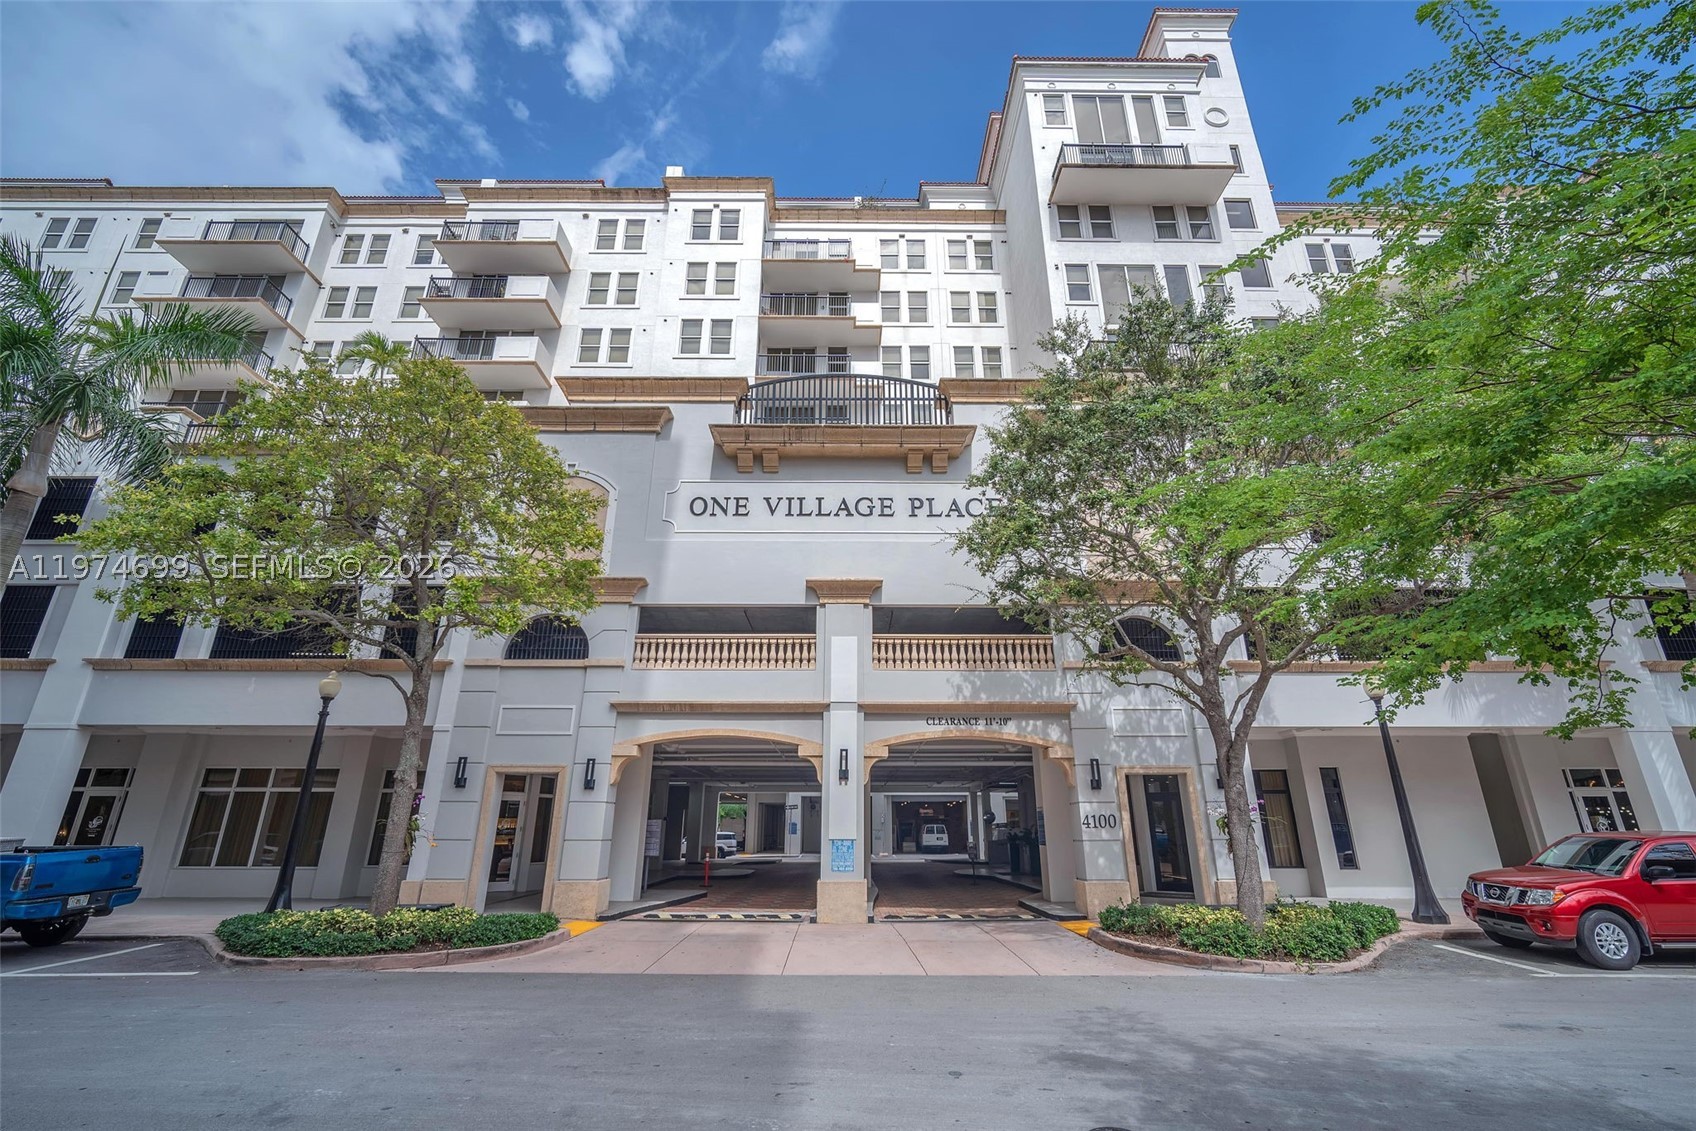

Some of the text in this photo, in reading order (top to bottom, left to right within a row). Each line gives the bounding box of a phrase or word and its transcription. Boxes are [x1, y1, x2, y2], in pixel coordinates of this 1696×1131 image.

[689, 496, 750, 517] ONE
[763, 496, 895, 518] VILLAGE
[926, 717, 981, 726] CLEARANCE
[1082, 813, 1117, 829] 4100
